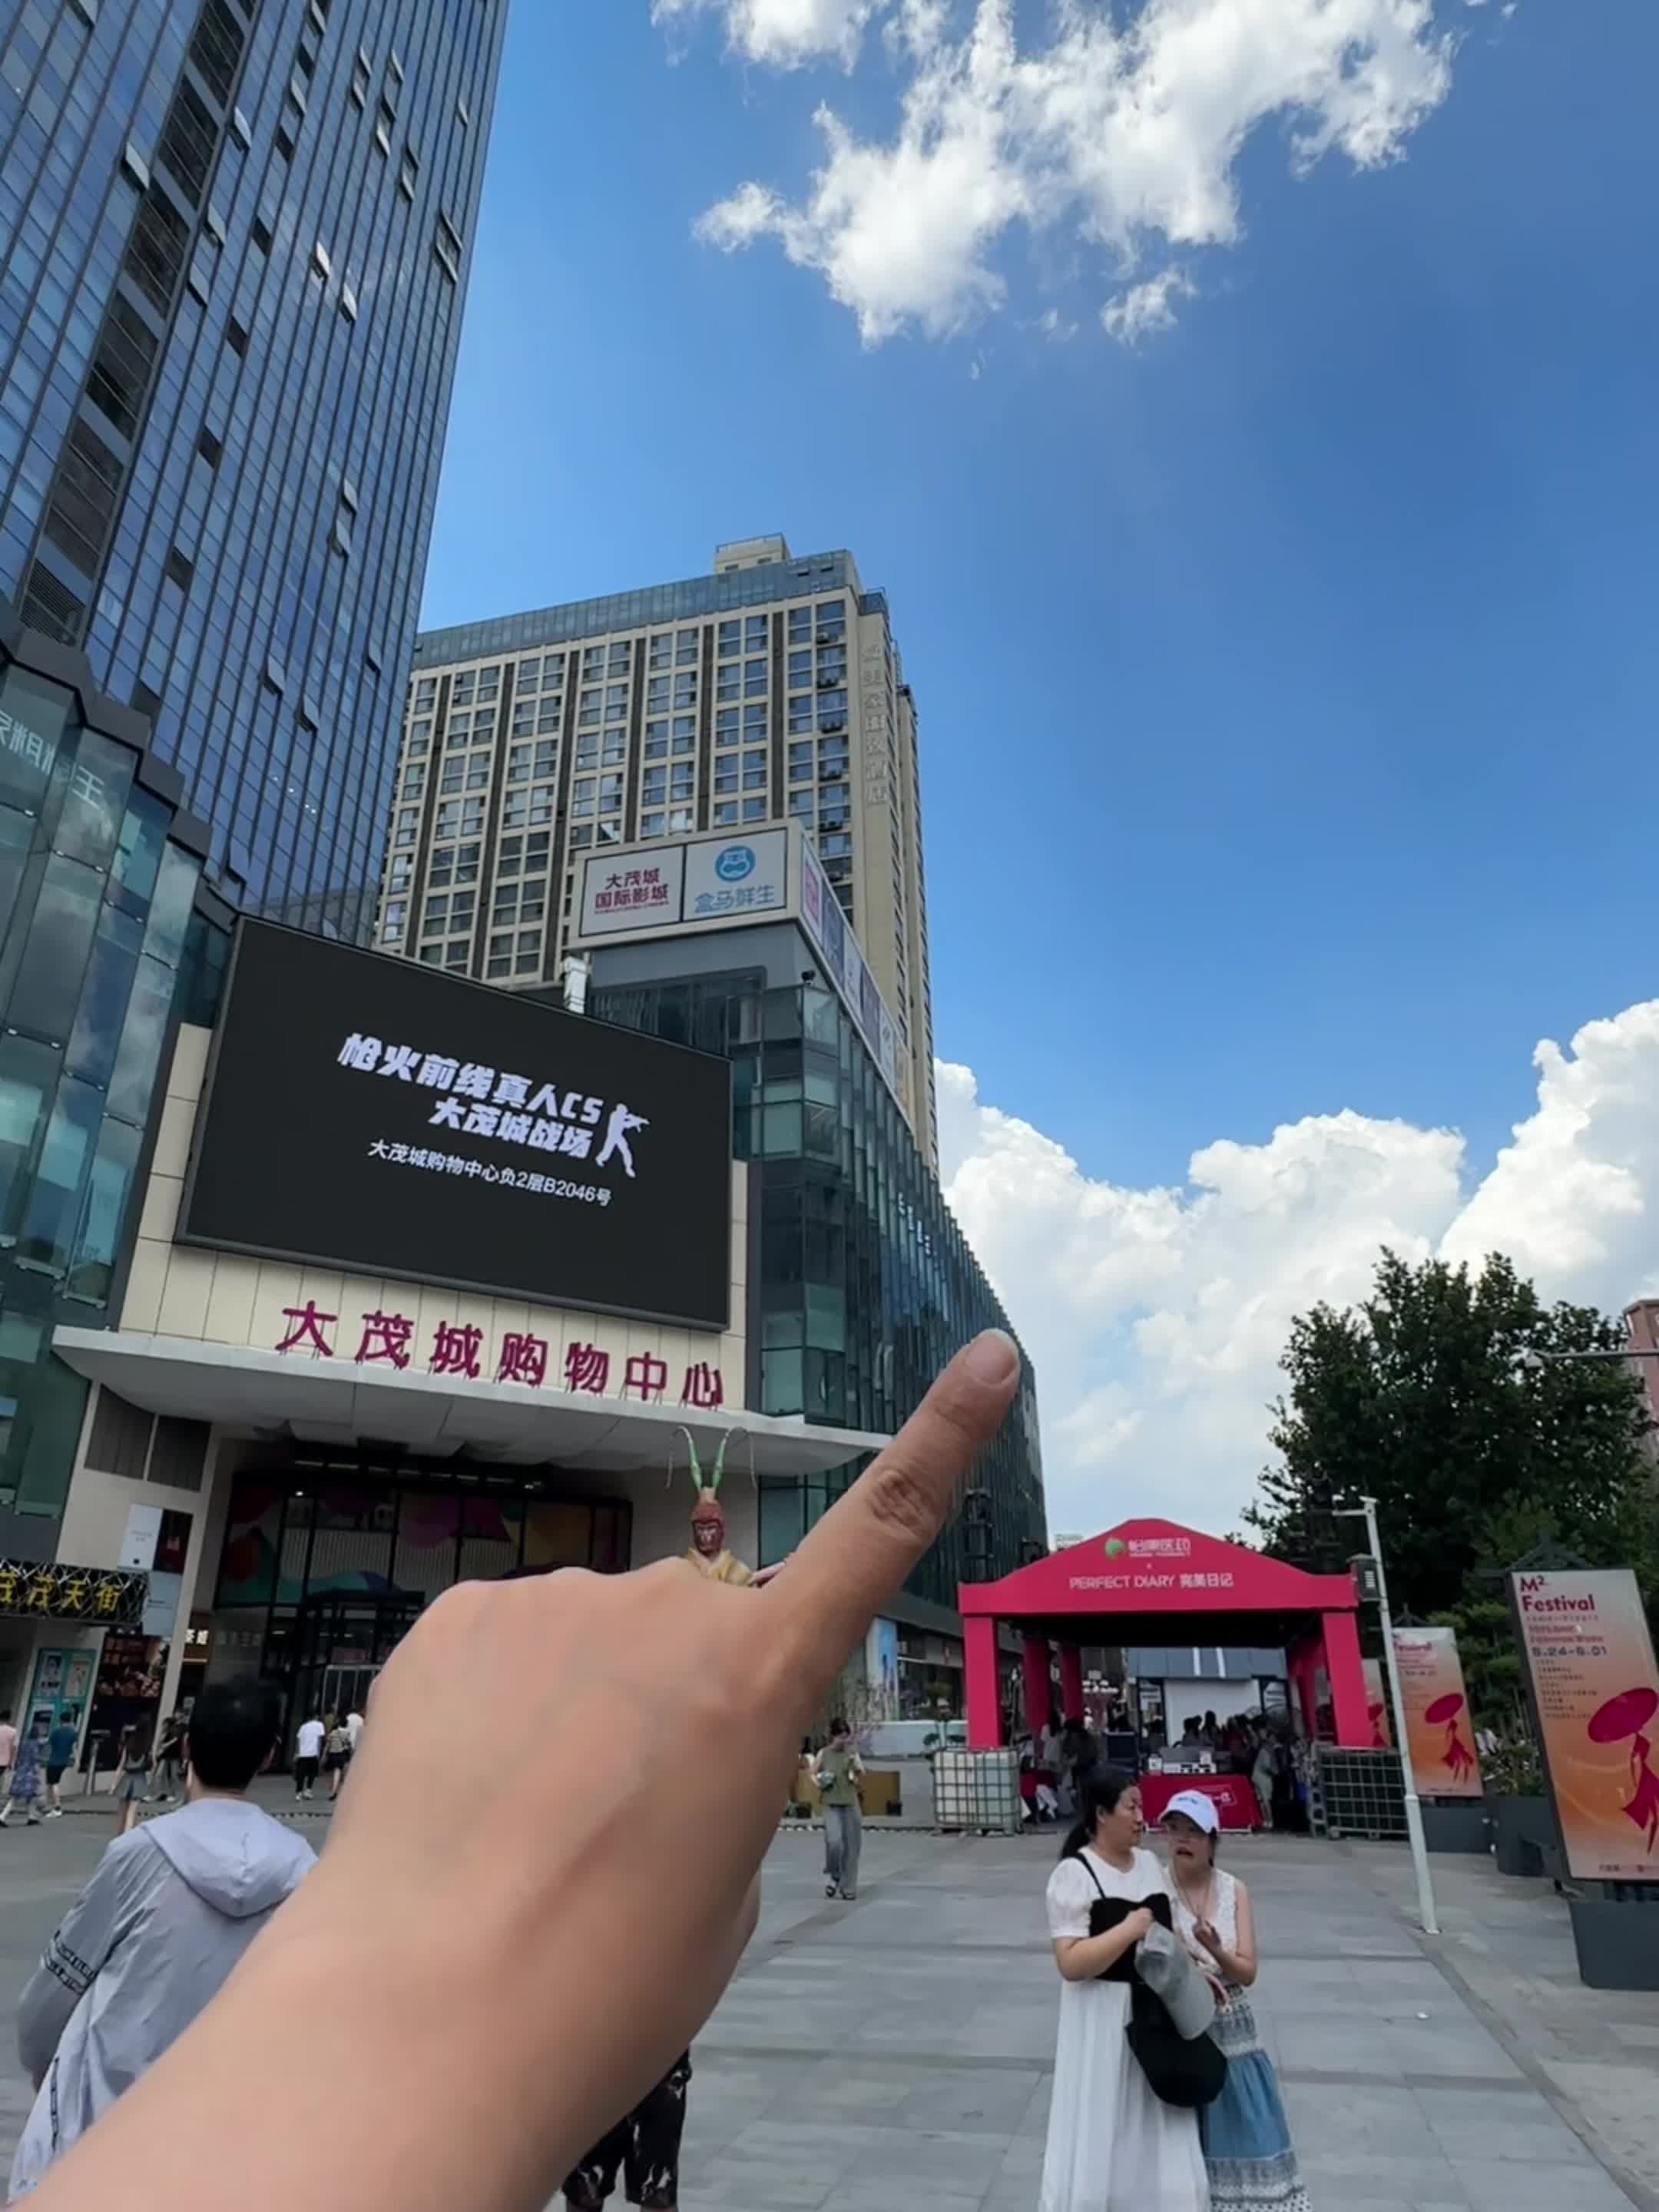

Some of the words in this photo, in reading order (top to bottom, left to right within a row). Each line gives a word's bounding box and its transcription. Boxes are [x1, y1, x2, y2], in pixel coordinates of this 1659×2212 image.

[604, 868, 660, 890] 大茂城
[595, 884, 670, 909] 国际影城
[694, 885, 775, 914] 盒马鲜生
[428, 1096, 594, 1159] 大茂城战场
[367, 1138, 614, 1207] 大茂城购物中心负2层B2046号
[275, 1300, 724, 1409] 大茂城购物中心
[1068, 1575, 1131, 1589] PERFECT
[1134, 1575, 1175, 1588] DIARY
[1522, 1594, 1596, 1612] Festival
